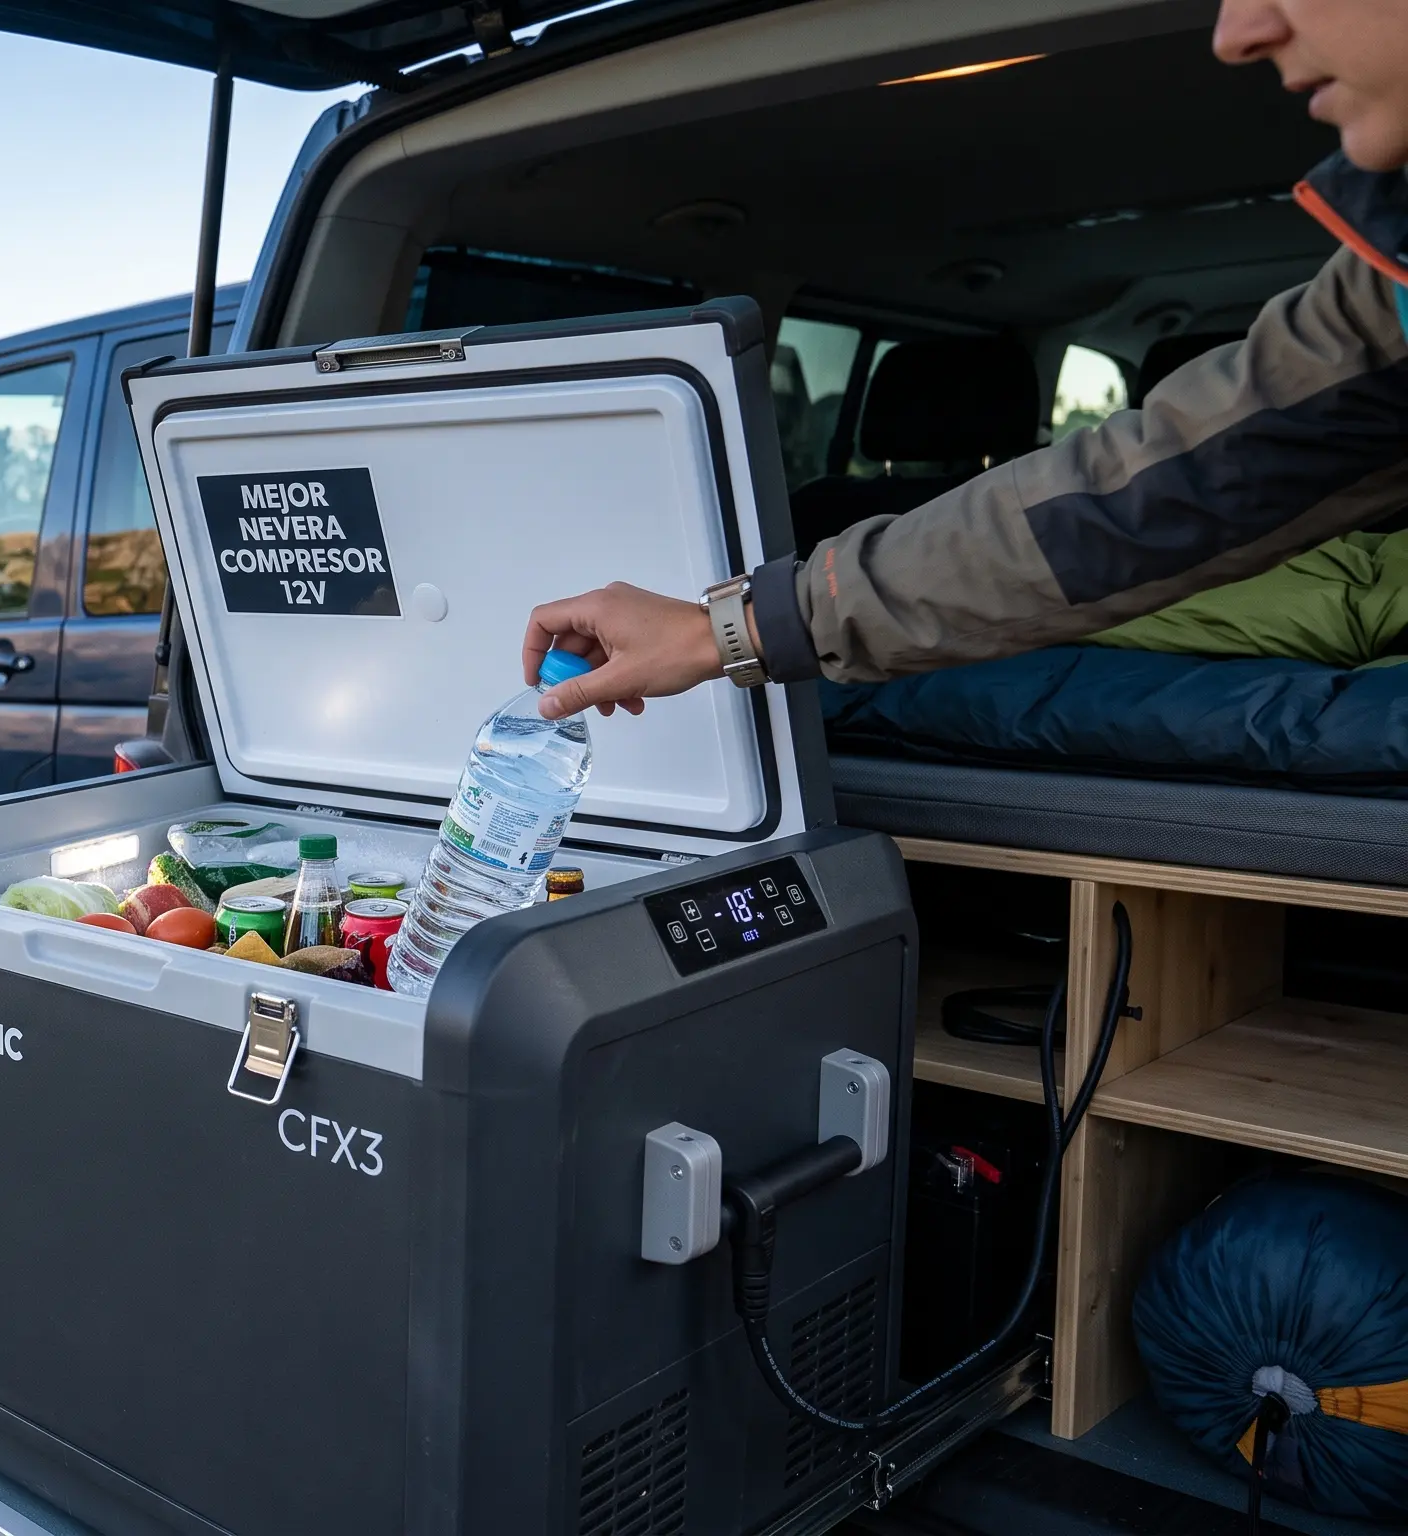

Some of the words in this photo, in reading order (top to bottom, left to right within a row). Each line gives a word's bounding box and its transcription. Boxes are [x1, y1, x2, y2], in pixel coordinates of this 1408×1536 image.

[241, 482, 329, 514] MEJOR
[239, 515, 347, 541] NEVERA
[220, 547, 387, 573] COMPRESOR
[280, 580, 326, 605] 12V
[278, 1108, 383, 1176] CFX3
